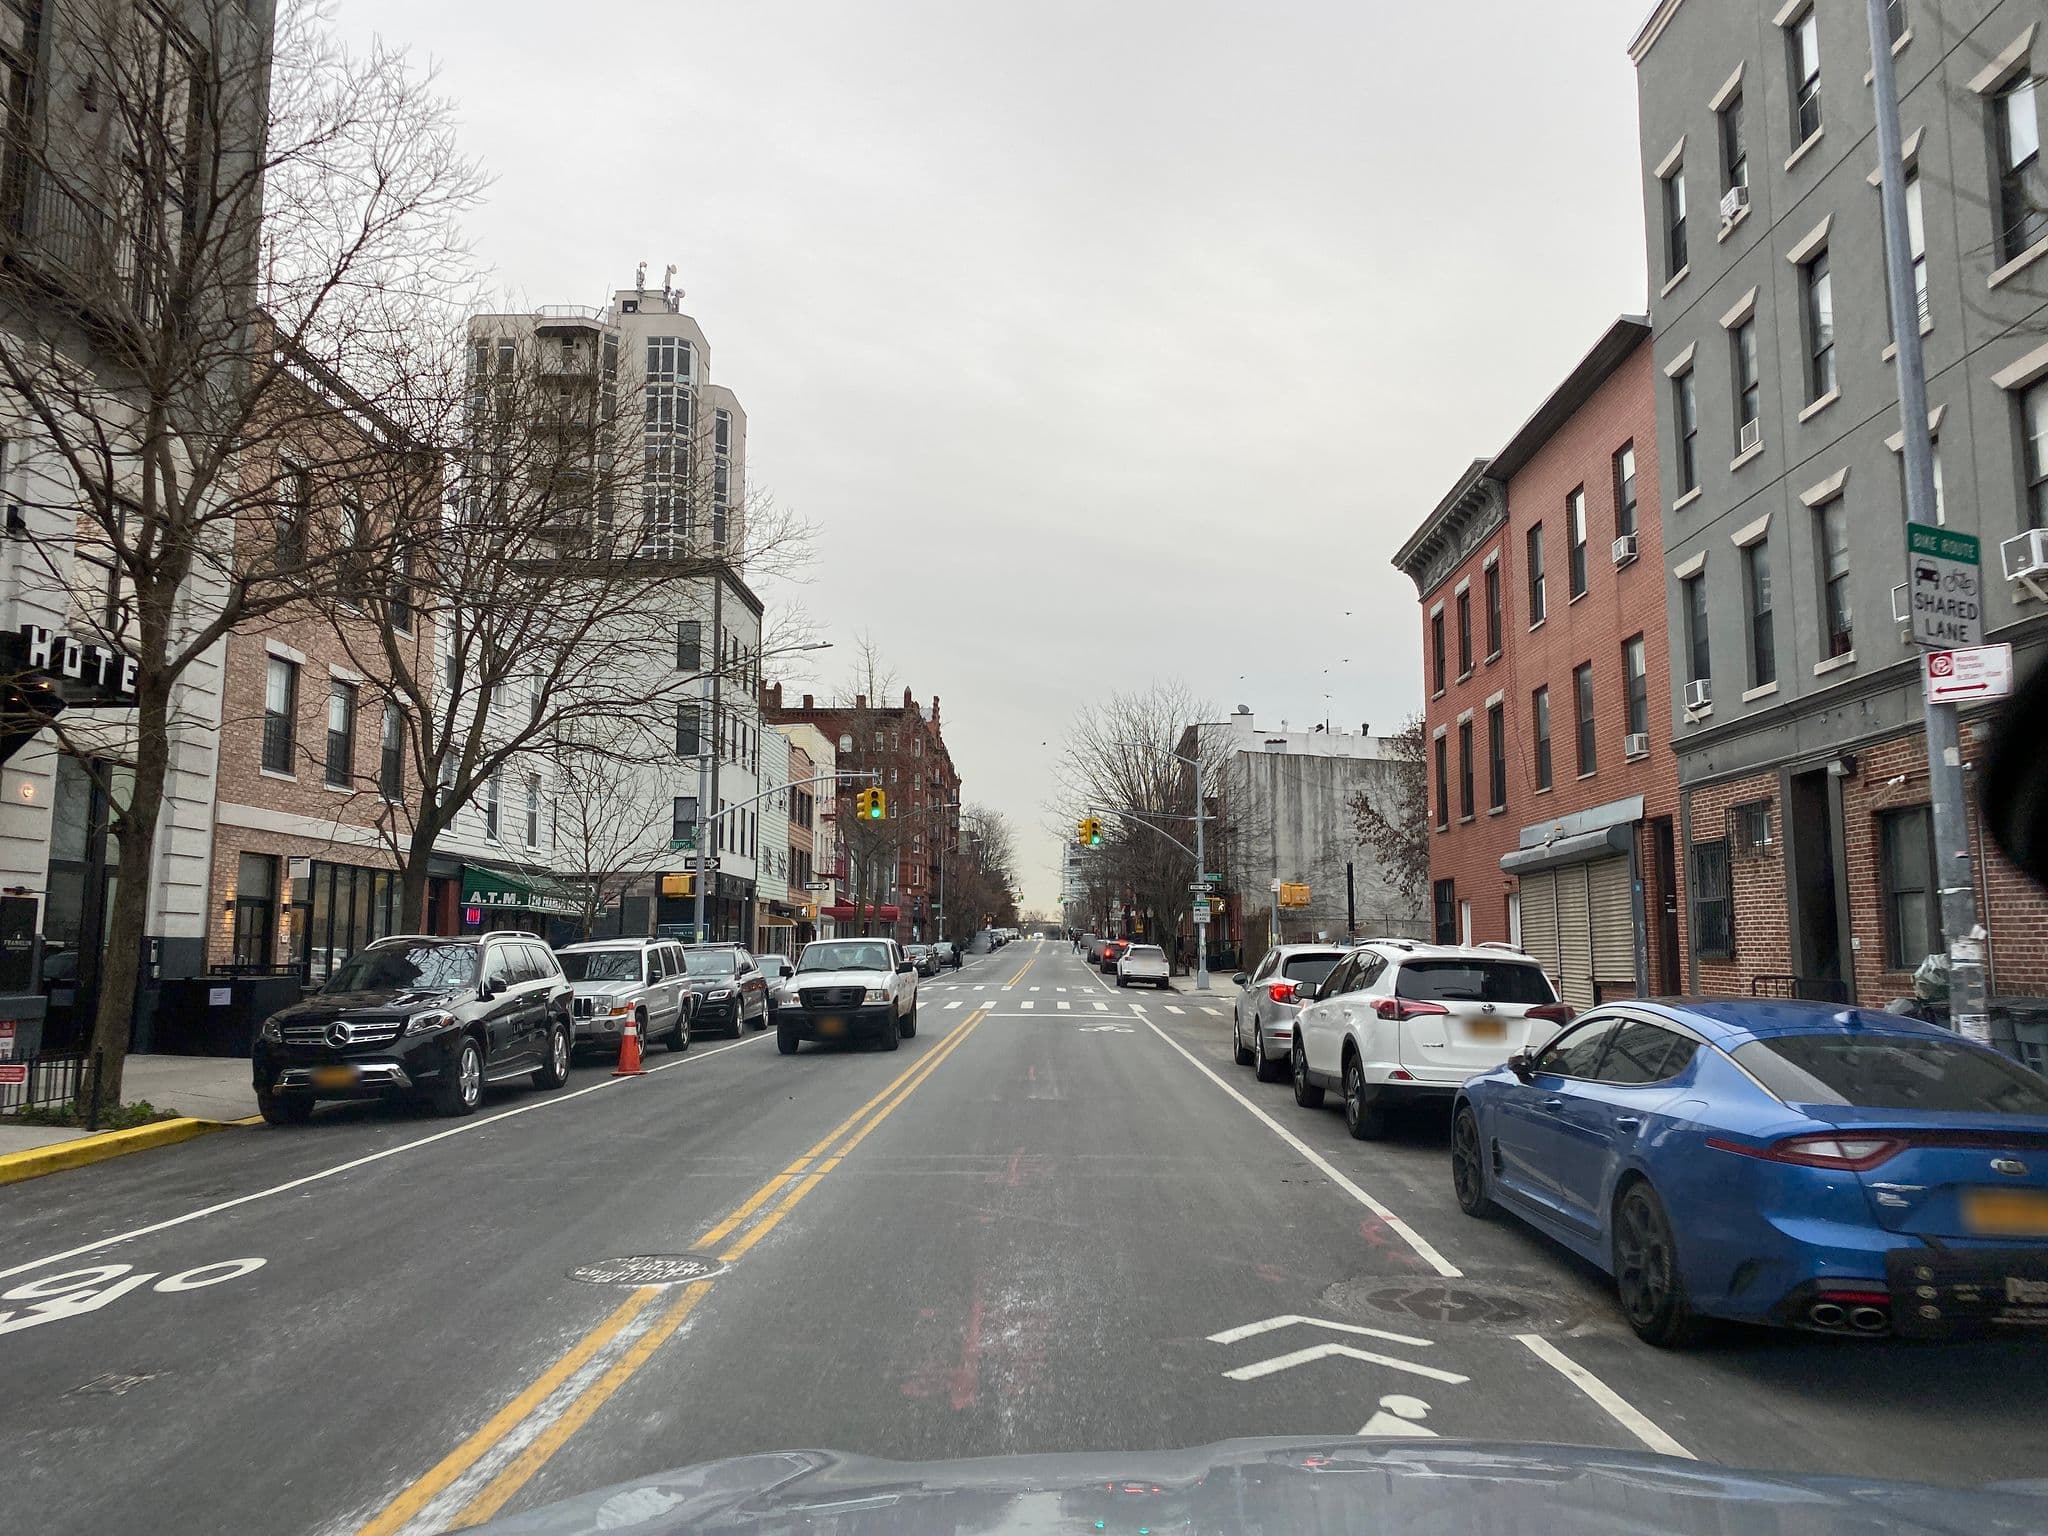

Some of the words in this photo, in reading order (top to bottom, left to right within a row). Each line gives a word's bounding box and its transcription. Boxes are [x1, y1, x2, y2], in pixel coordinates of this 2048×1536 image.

[1913, 532, 1938, 551] BIKE
[1914, 592, 1979, 620] SHARED
[1925, 618, 1969, 642] LANE
[28, 624, 139, 694] HOTE
[470, 890, 522, 905] A.T.M.
